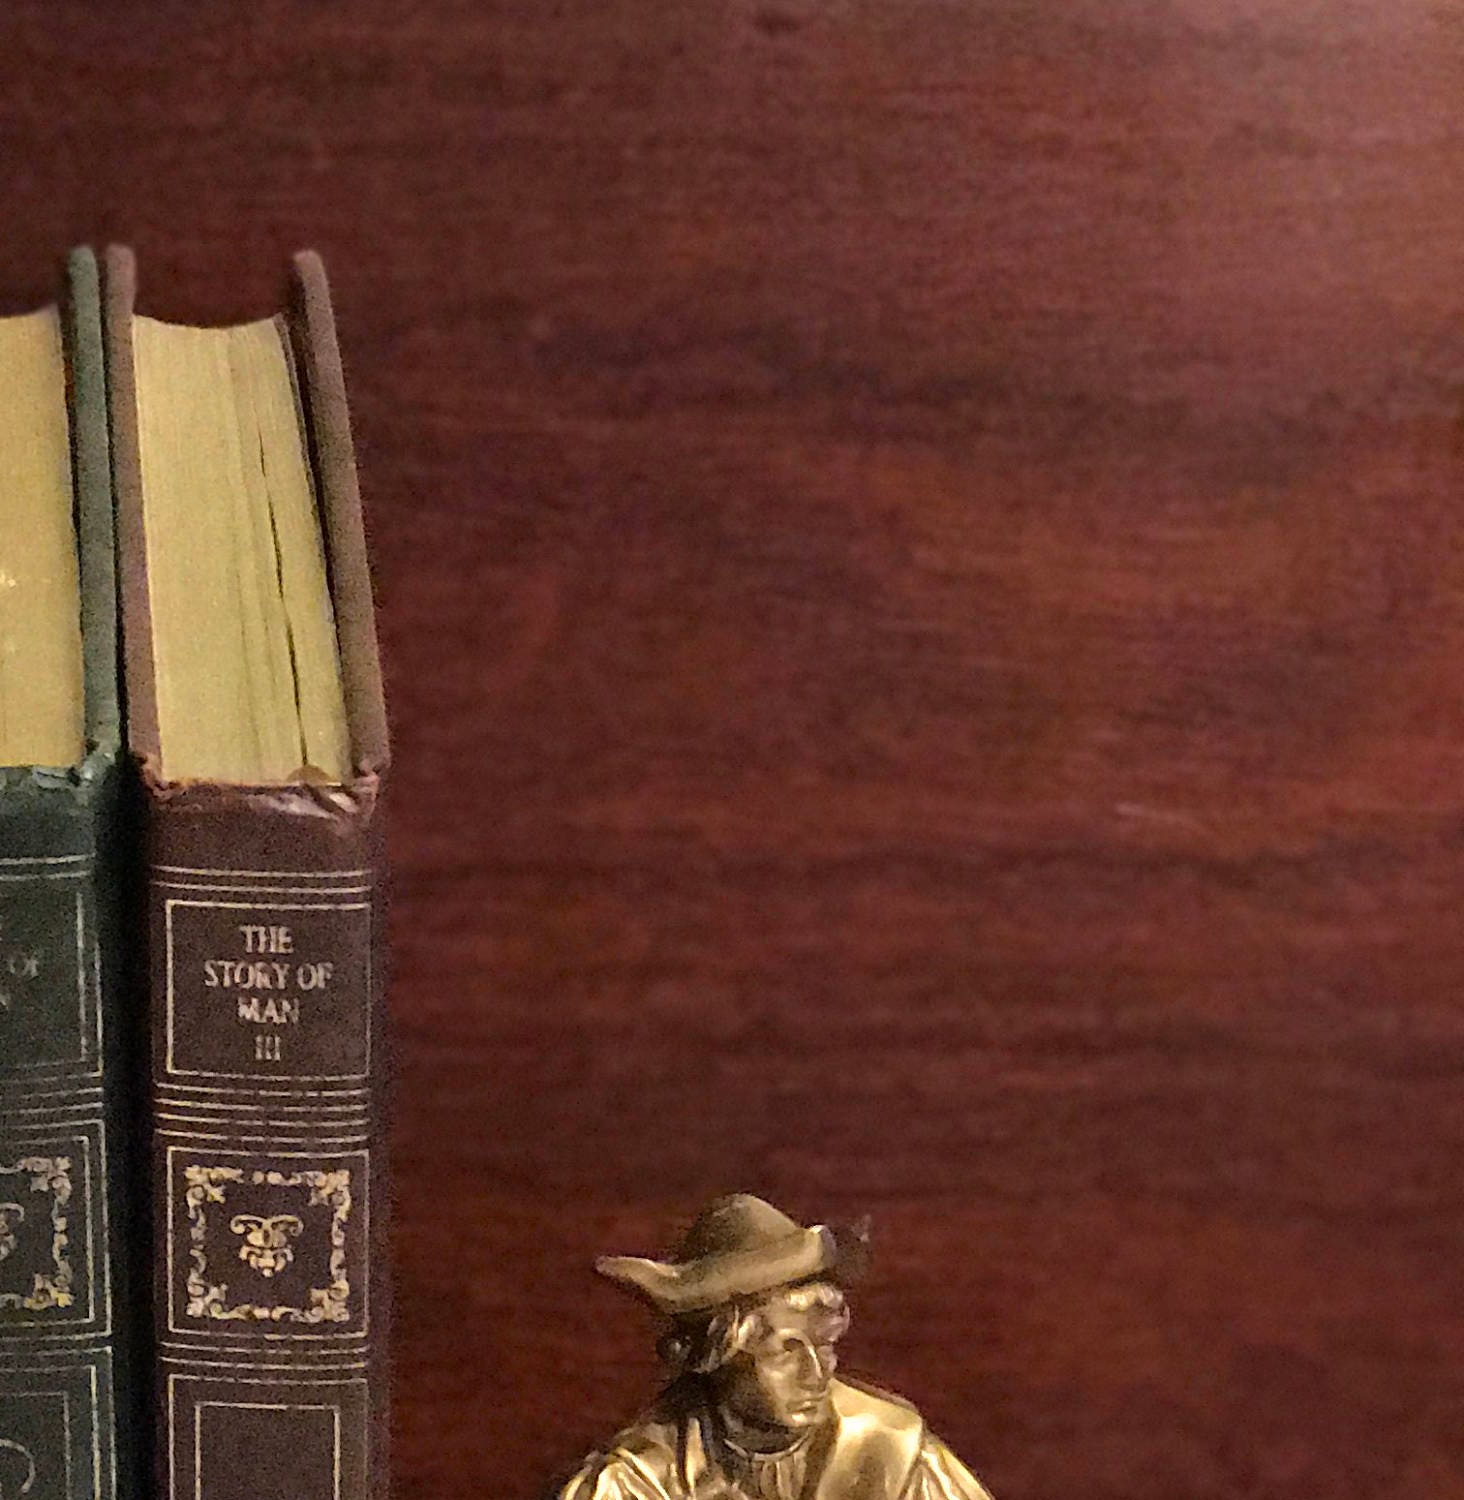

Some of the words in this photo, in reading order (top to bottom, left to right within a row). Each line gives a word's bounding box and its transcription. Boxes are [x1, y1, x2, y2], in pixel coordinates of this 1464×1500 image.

[238, 925, 294, 954] THE
[7, 948, 44, 977] OF
[203, 959, 291, 990] STORY
[296, 961, 334, 990] OF
[237, 997, 300, 1024] MAN
[255, 1034, 282, 1061] III
